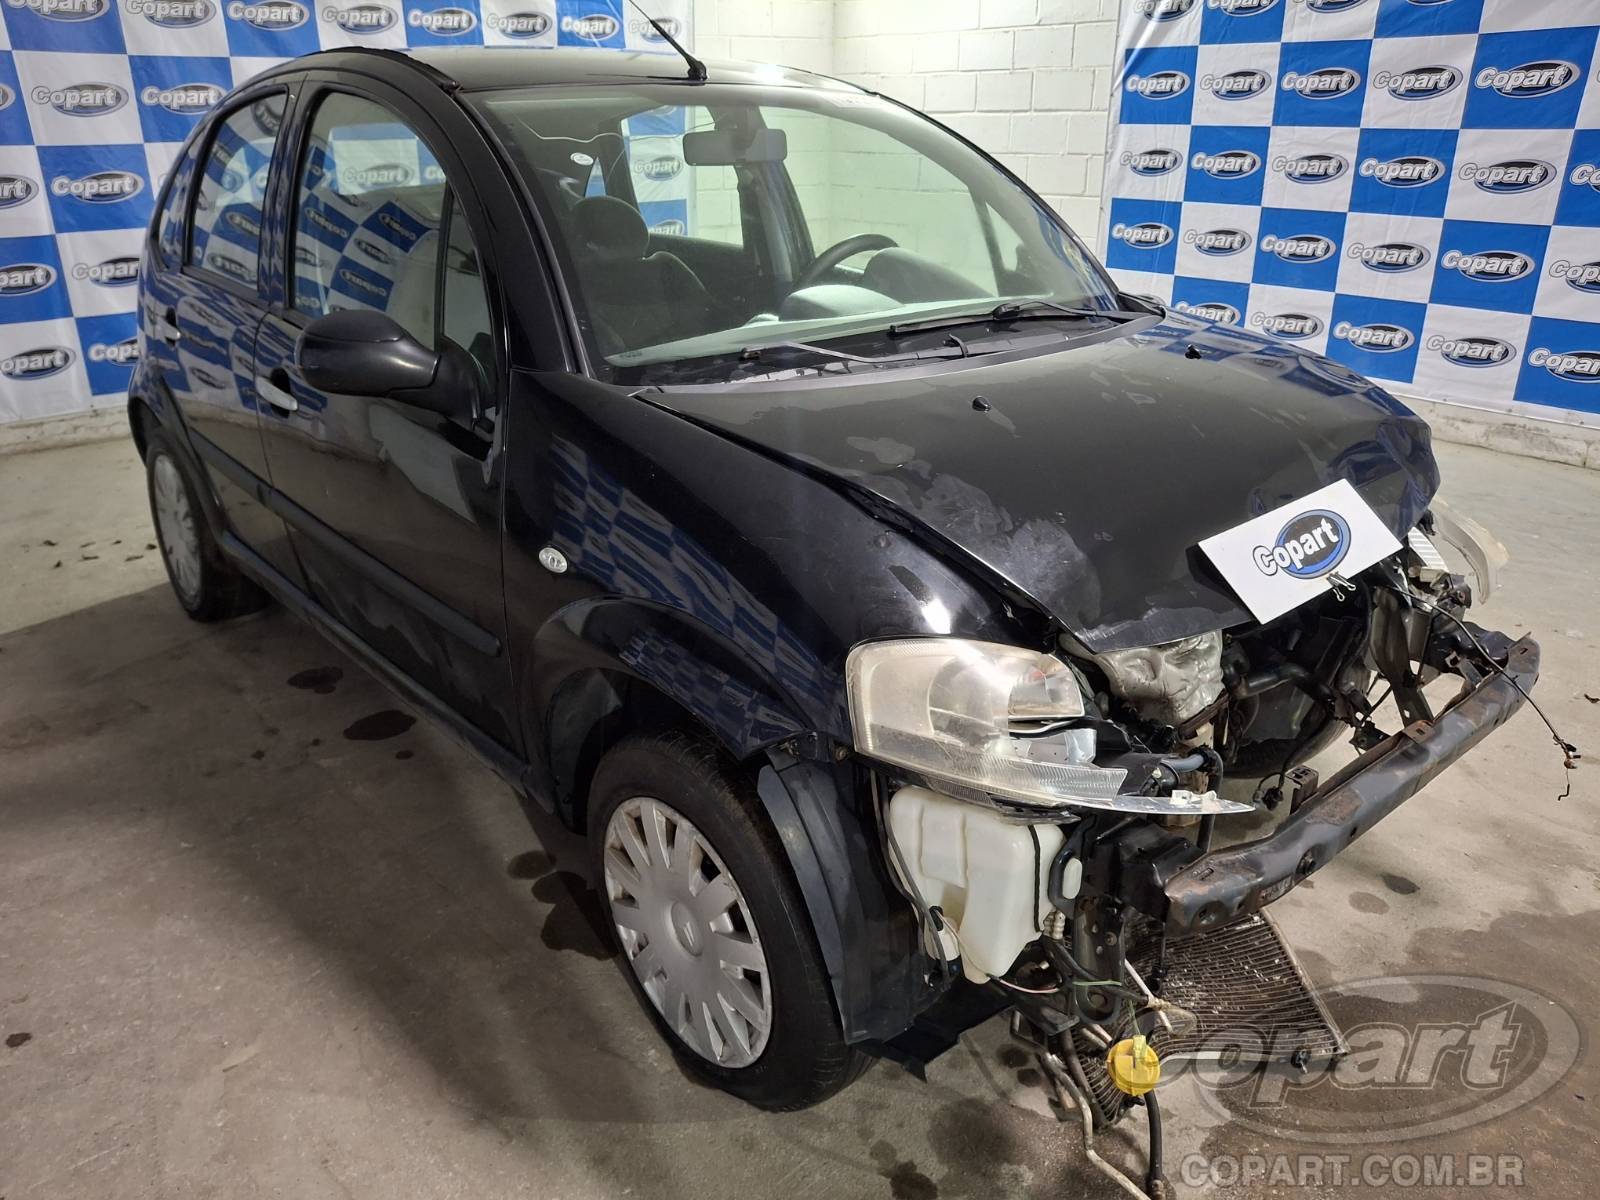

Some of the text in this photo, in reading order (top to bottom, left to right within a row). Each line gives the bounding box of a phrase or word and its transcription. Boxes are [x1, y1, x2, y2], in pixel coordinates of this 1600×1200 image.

[126, 0, 206, 19] Copart
[228, 2, 300, 23] Copart
[322, 6, 388, 26] Copart
[408, 9, 469, 31] Copart
[486, 12, 545, 32] Copart
[560, 15, 613, 36] Copart
[1126, 75, 1183, 94] Copart
[1200, 74, 1262, 94] Copart
[1281, 72, 1352, 94] Copart
[1373, 70, 1452, 94] Copart
[1475, 64, 1568, 92] Copart
[31, 85, 117, 110] Copart
[141, 86, 219, 108] Copart
[633, 157, 681, 177] Copart
[1120, 151, 1175, 170] Copart
[1191, 152, 1253, 172] Copart
[1271, 156, 1340, 178] Copart
[1359, 157, 1434, 181] Copart
[342, 166, 406, 187] Copart
[1458, 162, 1545, 186] Copart
[51, 176, 134, 200] Copart
[1111, 223, 1167, 244] Copart
[1183, 229, 1244, 250] Copart
[1260, 235, 1327, 257] Copart
[1347, 242, 1420, 264] Copart
[72, 262, 139, 283] Copar
[1441, 250, 1524, 275] Copart
[1549, 260, 1600, 285] Cop
[0, 266, 46, 291] part
[1250, 311, 1319, 334] Copart
[1333, 320, 1404, 347] Copart
[89, 343, 139, 363] Copa
[1426, 335, 1508, 360] Copart
[0, 350, 64, 375] opart
[1528, 347, 1600, 374] Copar
[1252, 517, 1340, 578] Copart
